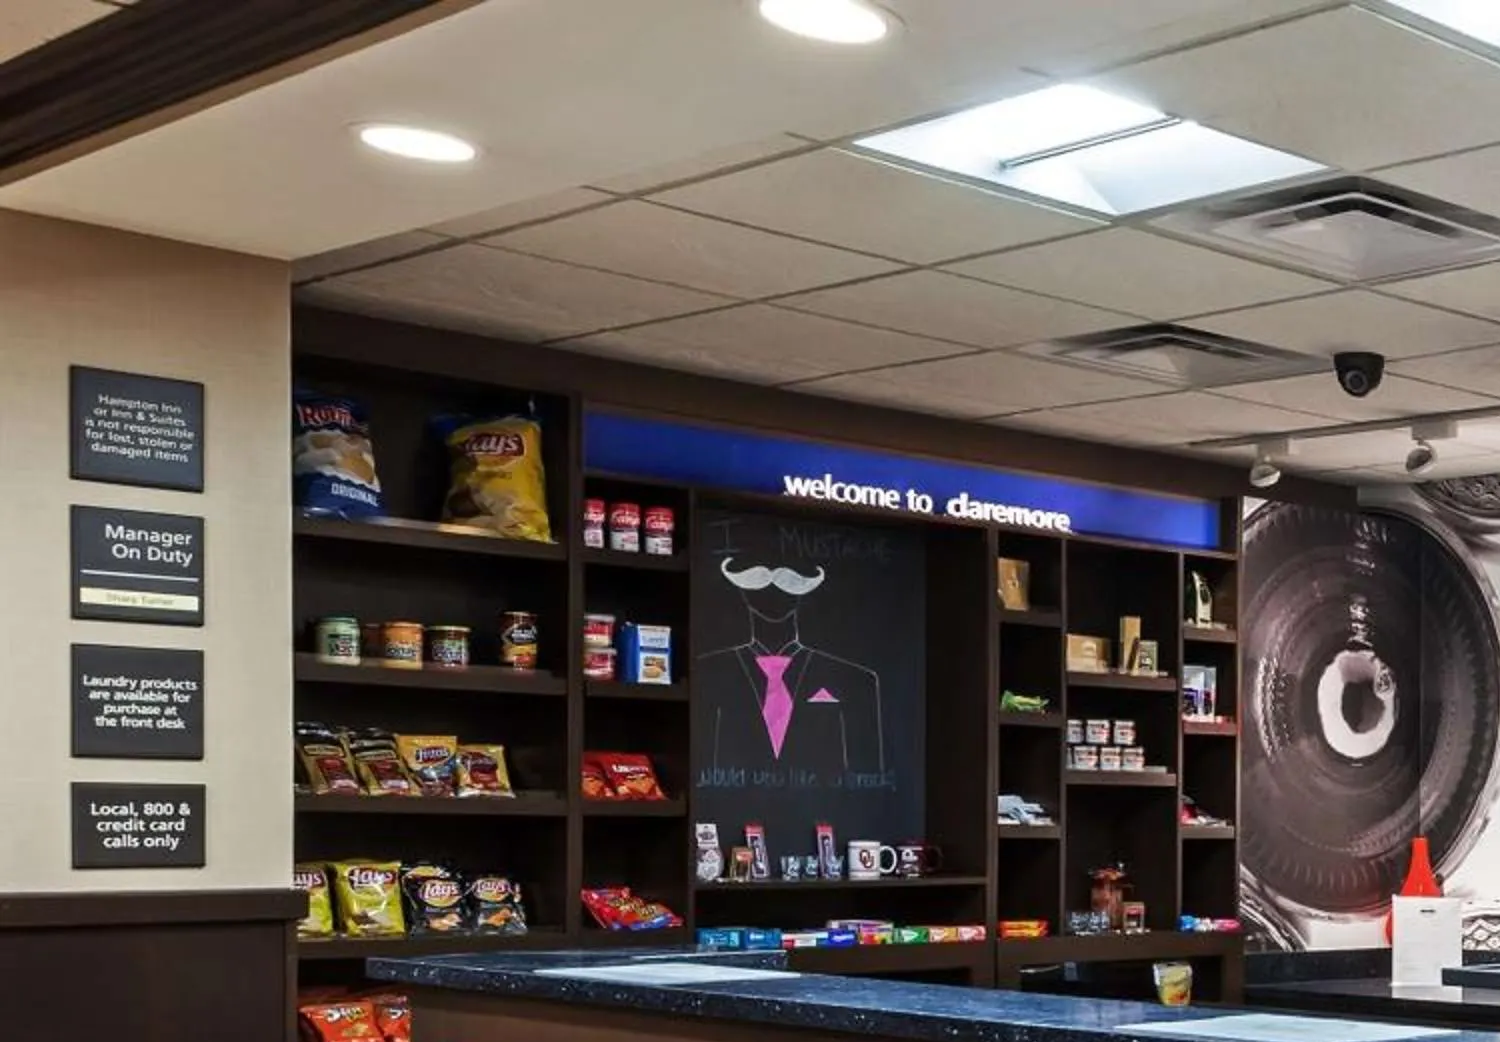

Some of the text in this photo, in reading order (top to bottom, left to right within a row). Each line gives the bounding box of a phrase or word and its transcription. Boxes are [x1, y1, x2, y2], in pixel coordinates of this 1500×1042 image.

[98, 394, 182, 414] Hampton Inn
[93, 408, 187, 427] or Inn & Suites
[85, 417, 196, 440] is not responsible
[85, 428, 105, 439] for
[139, 436, 177, 450] stolen
[179, 441, 193, 451] or
[91, 442, 190, 463] damaged items
[784, 474, 1072, 531] welcome to claremore
[105, 523, 193, 547] Manager
[112, 543, 193, 567] On Duty
[83, 674, 198, 691] Laundry products
[89, 689, 191, 703] are available for
[103, 702, 178, 716] purchase at
[95, 715, 186, 729] the front desk
[90, 801, 191, 817] Local, 800 &
[96, 817, 185, 832] credit card
[103, 833, 179, 851] calls only
